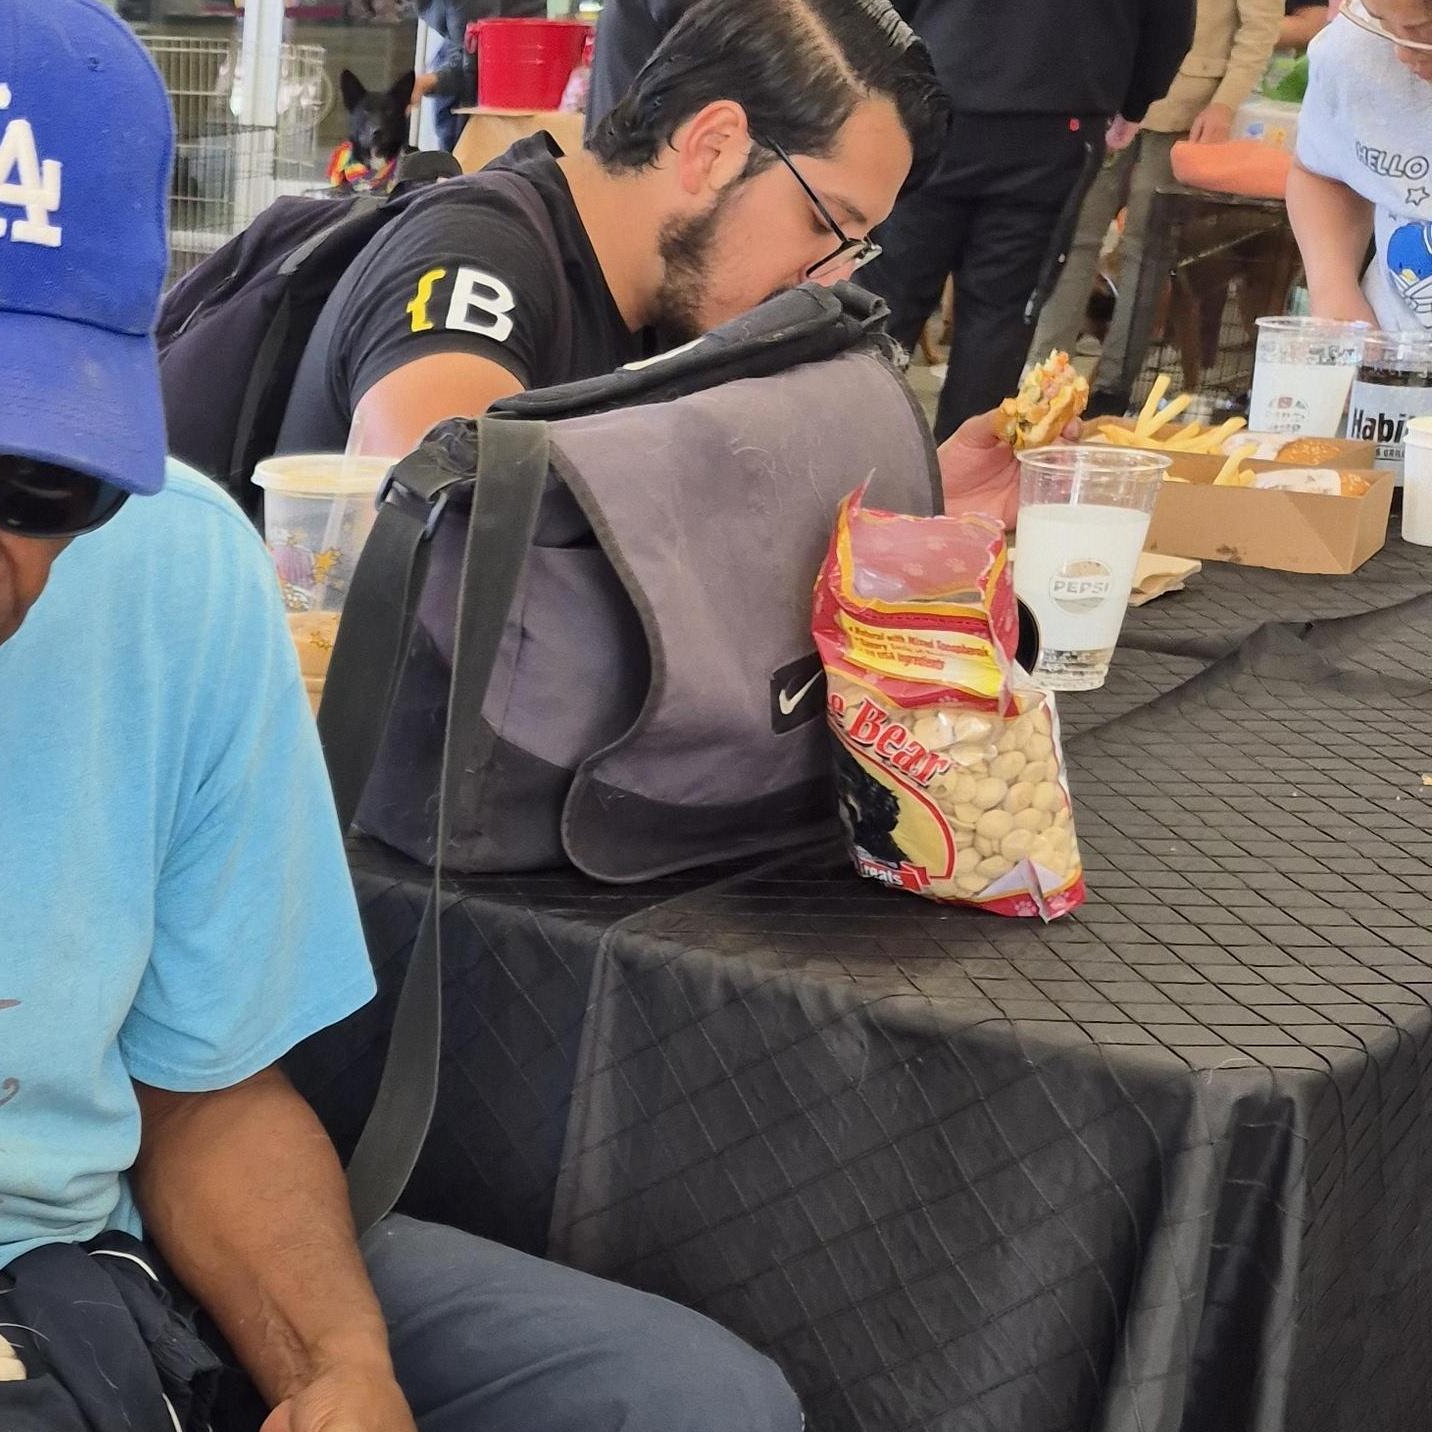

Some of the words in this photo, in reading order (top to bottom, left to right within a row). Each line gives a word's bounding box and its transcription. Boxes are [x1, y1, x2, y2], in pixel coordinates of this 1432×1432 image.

[1355, 141, 1430, 180] HELLO
[1351, 408, 1415, 443] Habi
[1054, 580, 1109, 594] PEPSI
[849, 696, 951, 787] Bear
